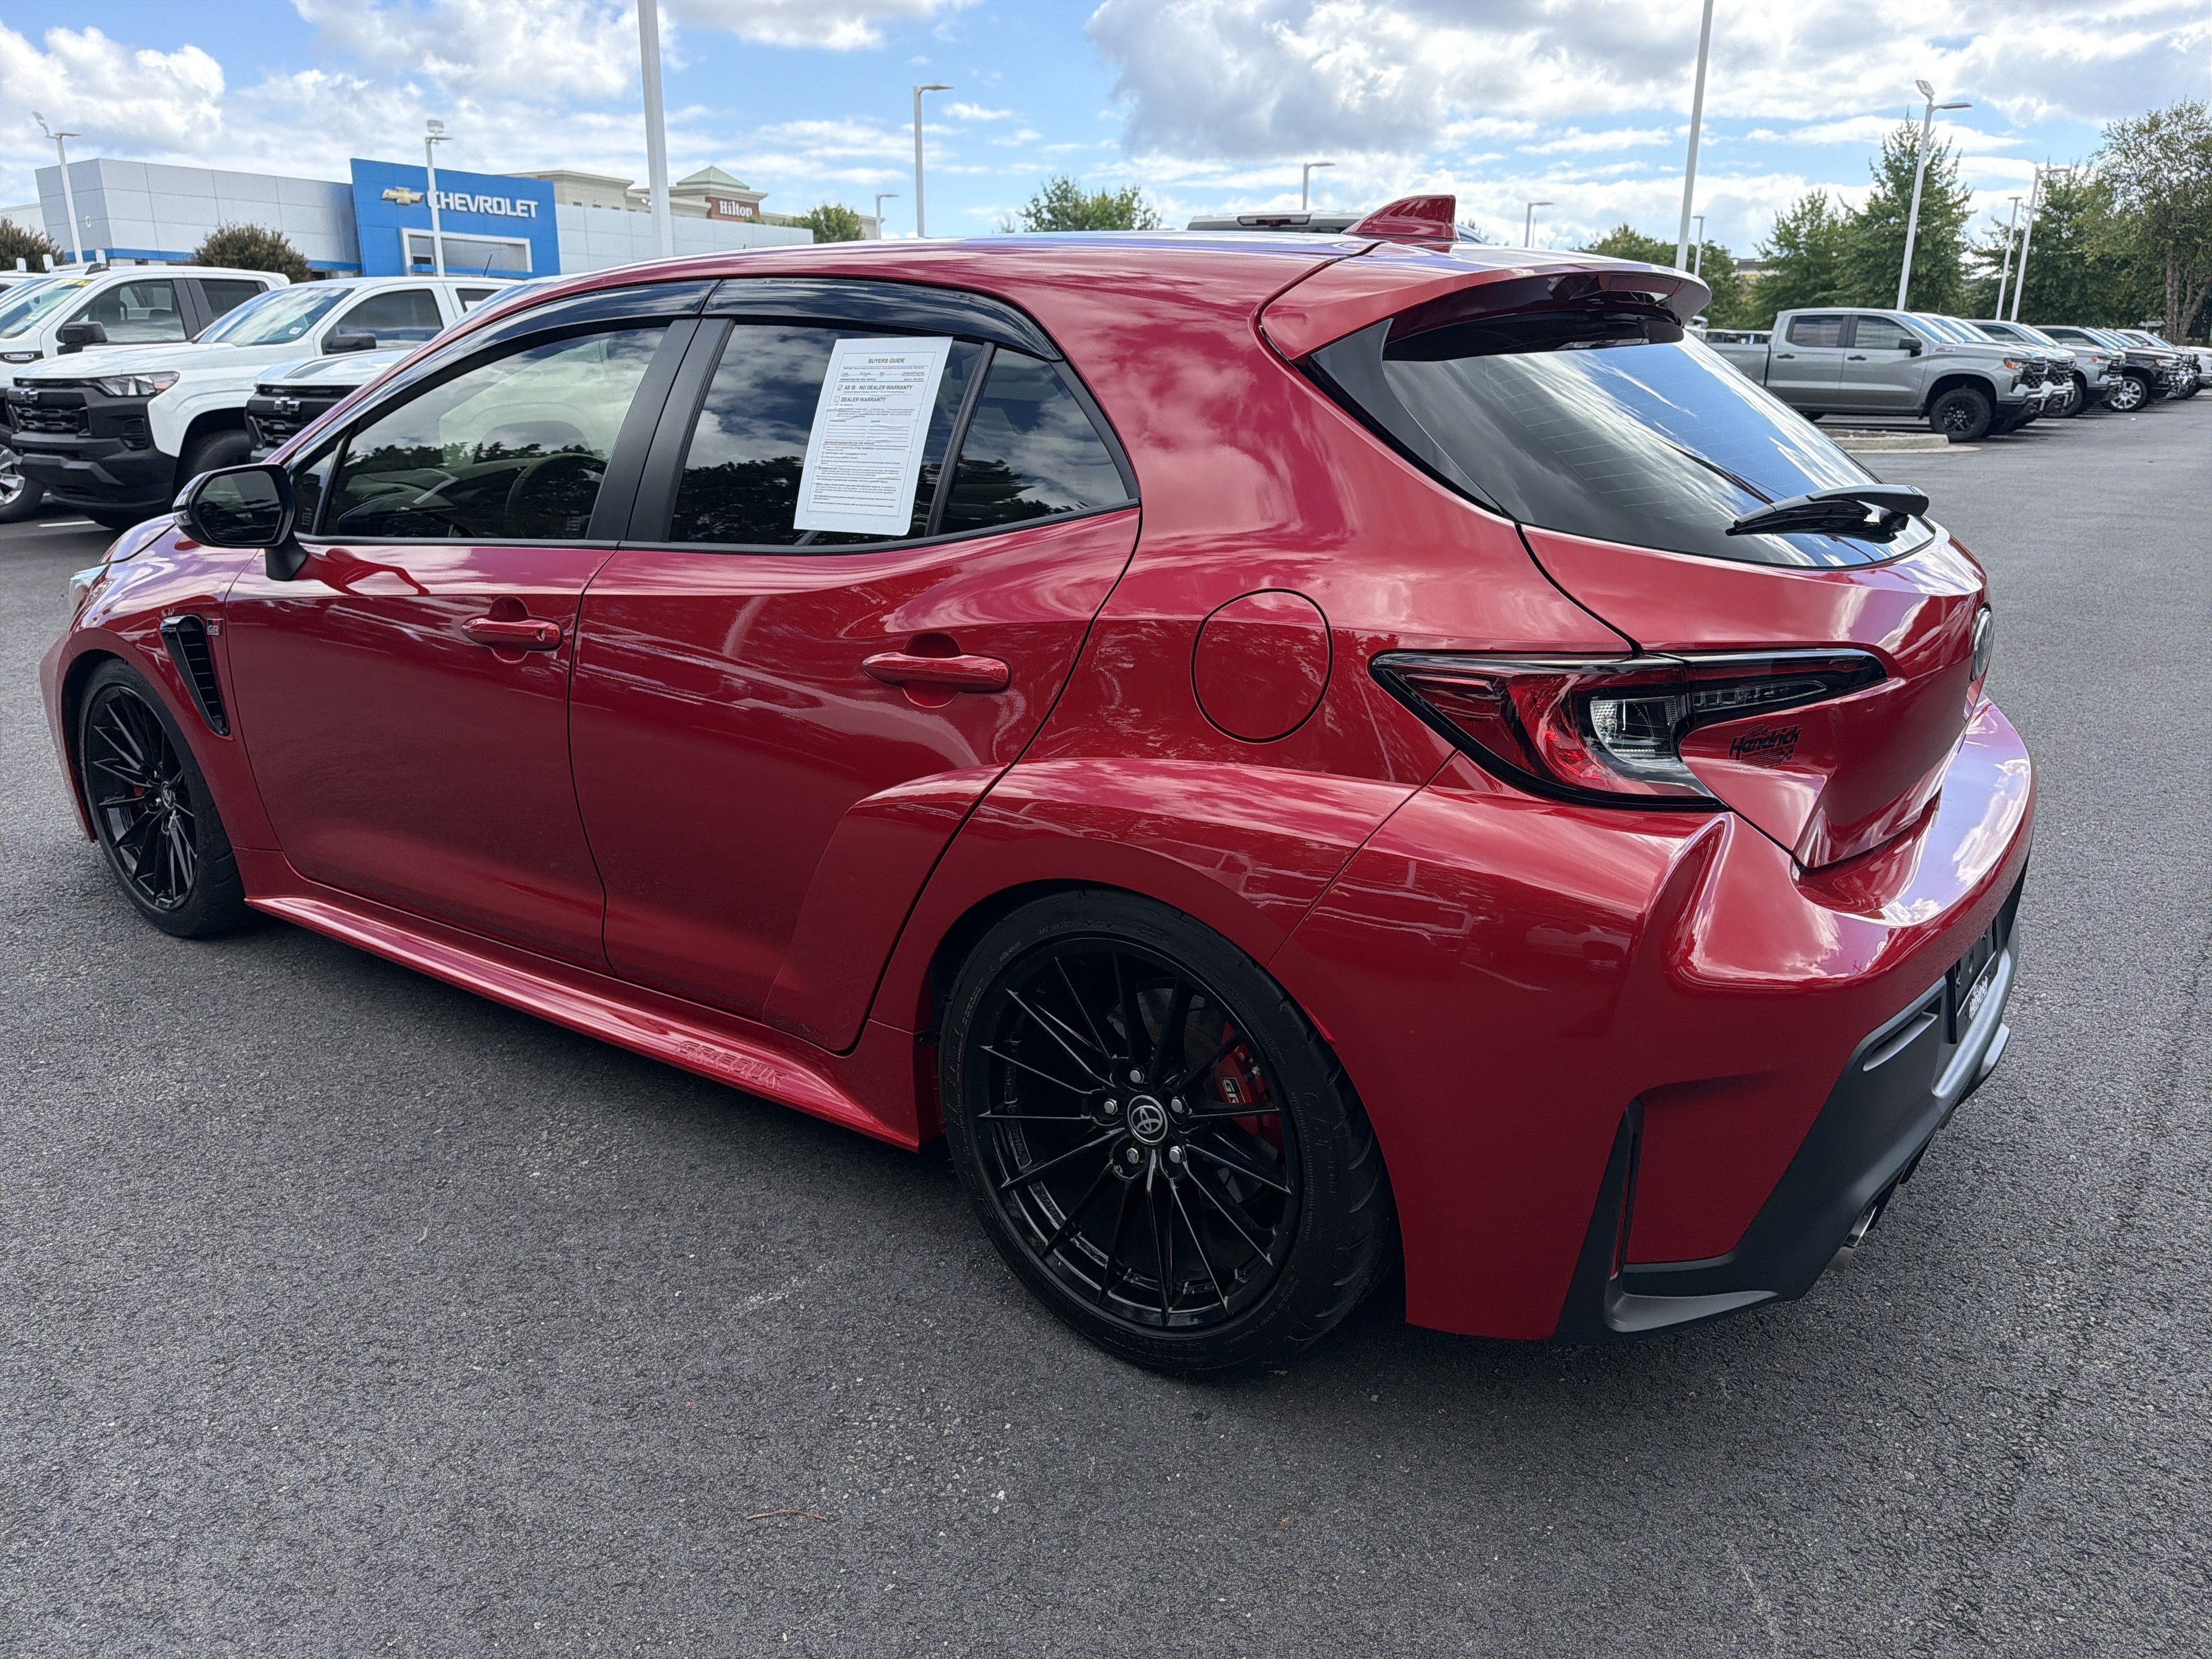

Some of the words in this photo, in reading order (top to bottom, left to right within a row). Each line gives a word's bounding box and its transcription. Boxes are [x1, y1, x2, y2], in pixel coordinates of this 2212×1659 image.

[427, 191, 539, 218] CHEVROLET
[719, 200, 753, 218] Hilton
[207, 625, 219, 635] GR
[1729, 725, 1803, 760] Hendrick
